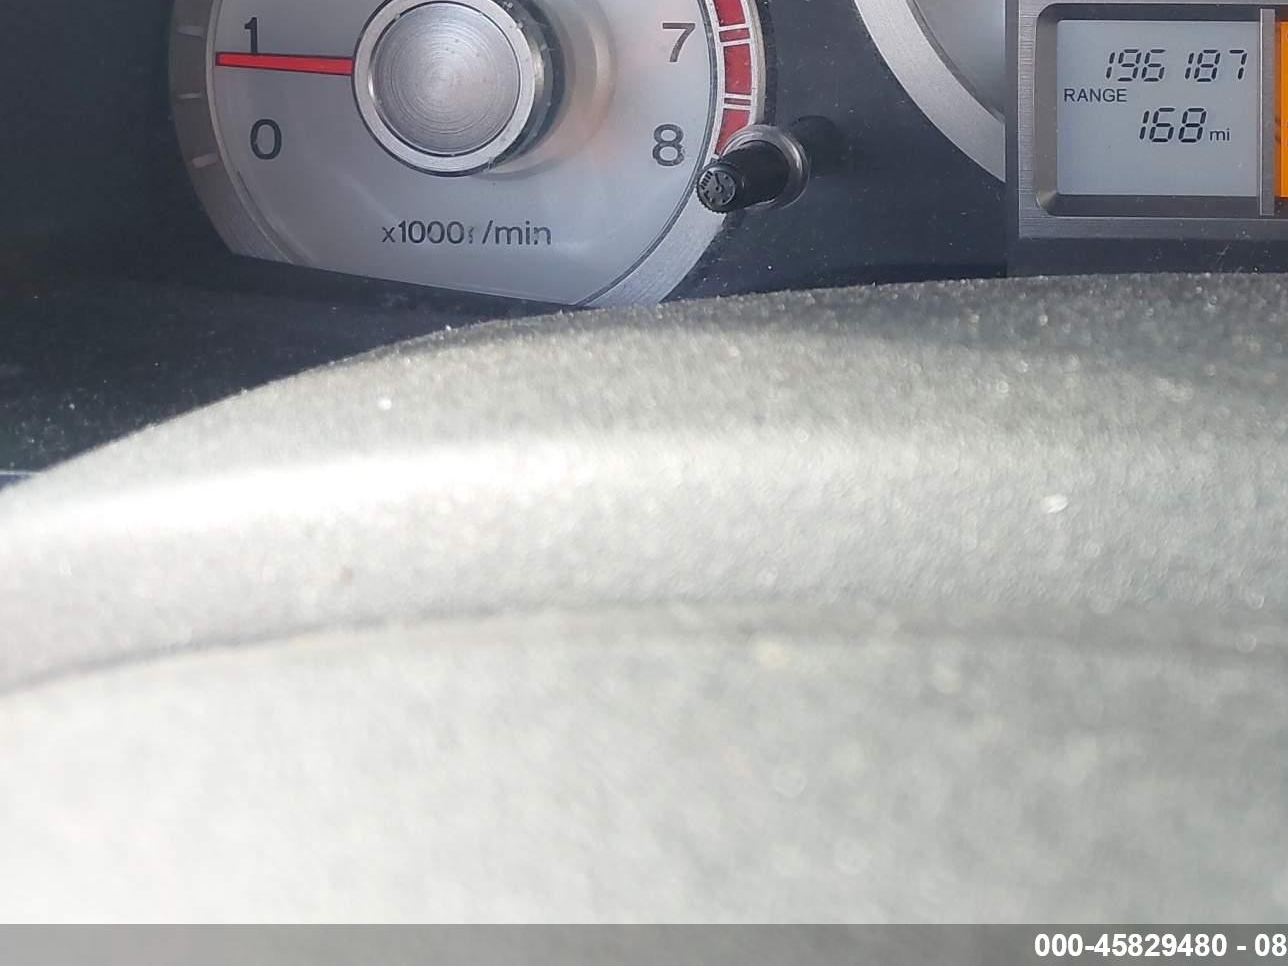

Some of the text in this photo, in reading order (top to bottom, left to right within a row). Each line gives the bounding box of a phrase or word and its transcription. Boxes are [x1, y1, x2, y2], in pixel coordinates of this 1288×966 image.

[244, 17, 259, 54] 1
[662, 22, 696, 62] 7
[1064, 88, 1127, 102] RANGE
[251, 120, 282, 160] 0
[1139, 107, 1230, 142] 168 mi
[652, 124, 685, 166] 8
